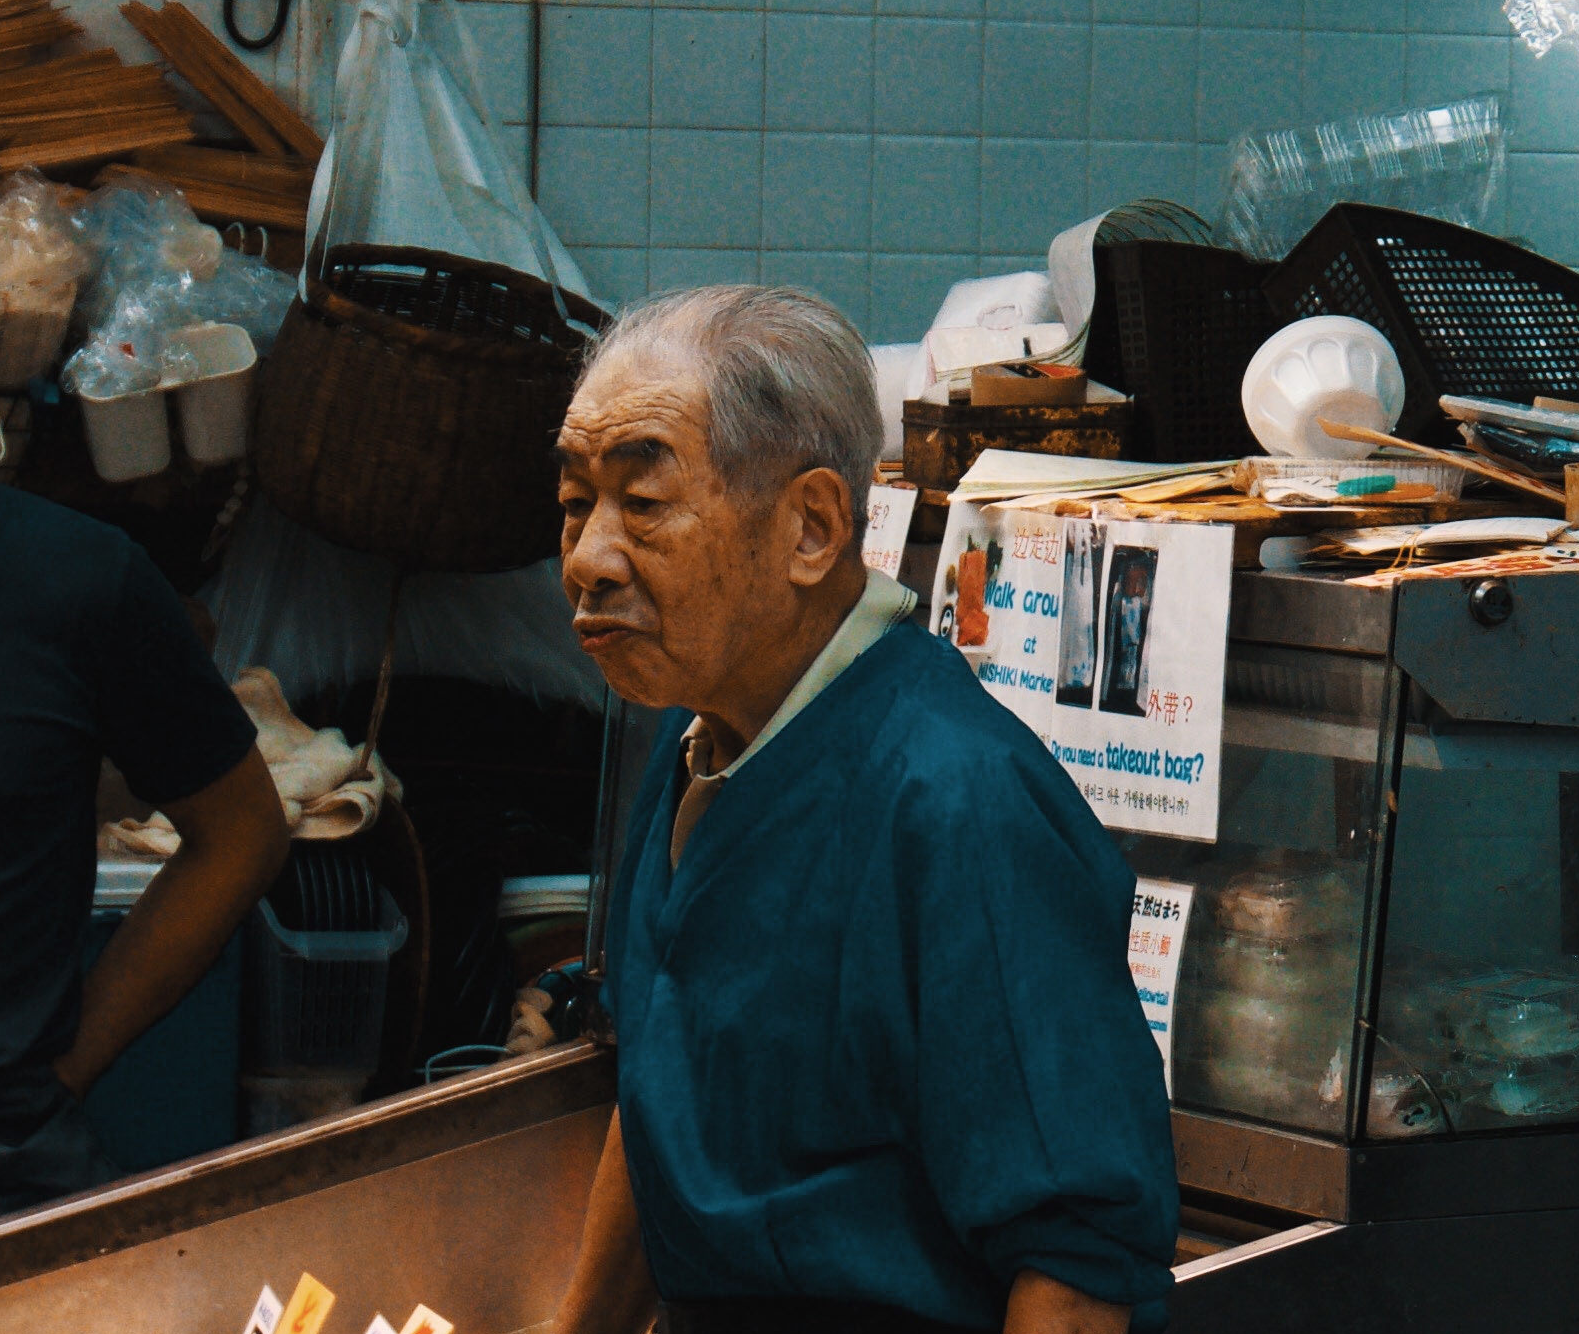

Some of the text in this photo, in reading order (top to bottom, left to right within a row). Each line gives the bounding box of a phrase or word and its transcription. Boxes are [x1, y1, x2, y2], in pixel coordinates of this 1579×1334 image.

[984, 578, 1016, 610] Walk
[1023, 636, 1037, 655] at
[978, 663, 1018, 686] NISHIKI
[1061, 747, 1077, 764] you
[1077, 747, 1097, 767] need
[1097, 754, 1104, 767] a
[1106, 741, 1161, 777] takeout
[1164, 749, 1204, 785] bag?
